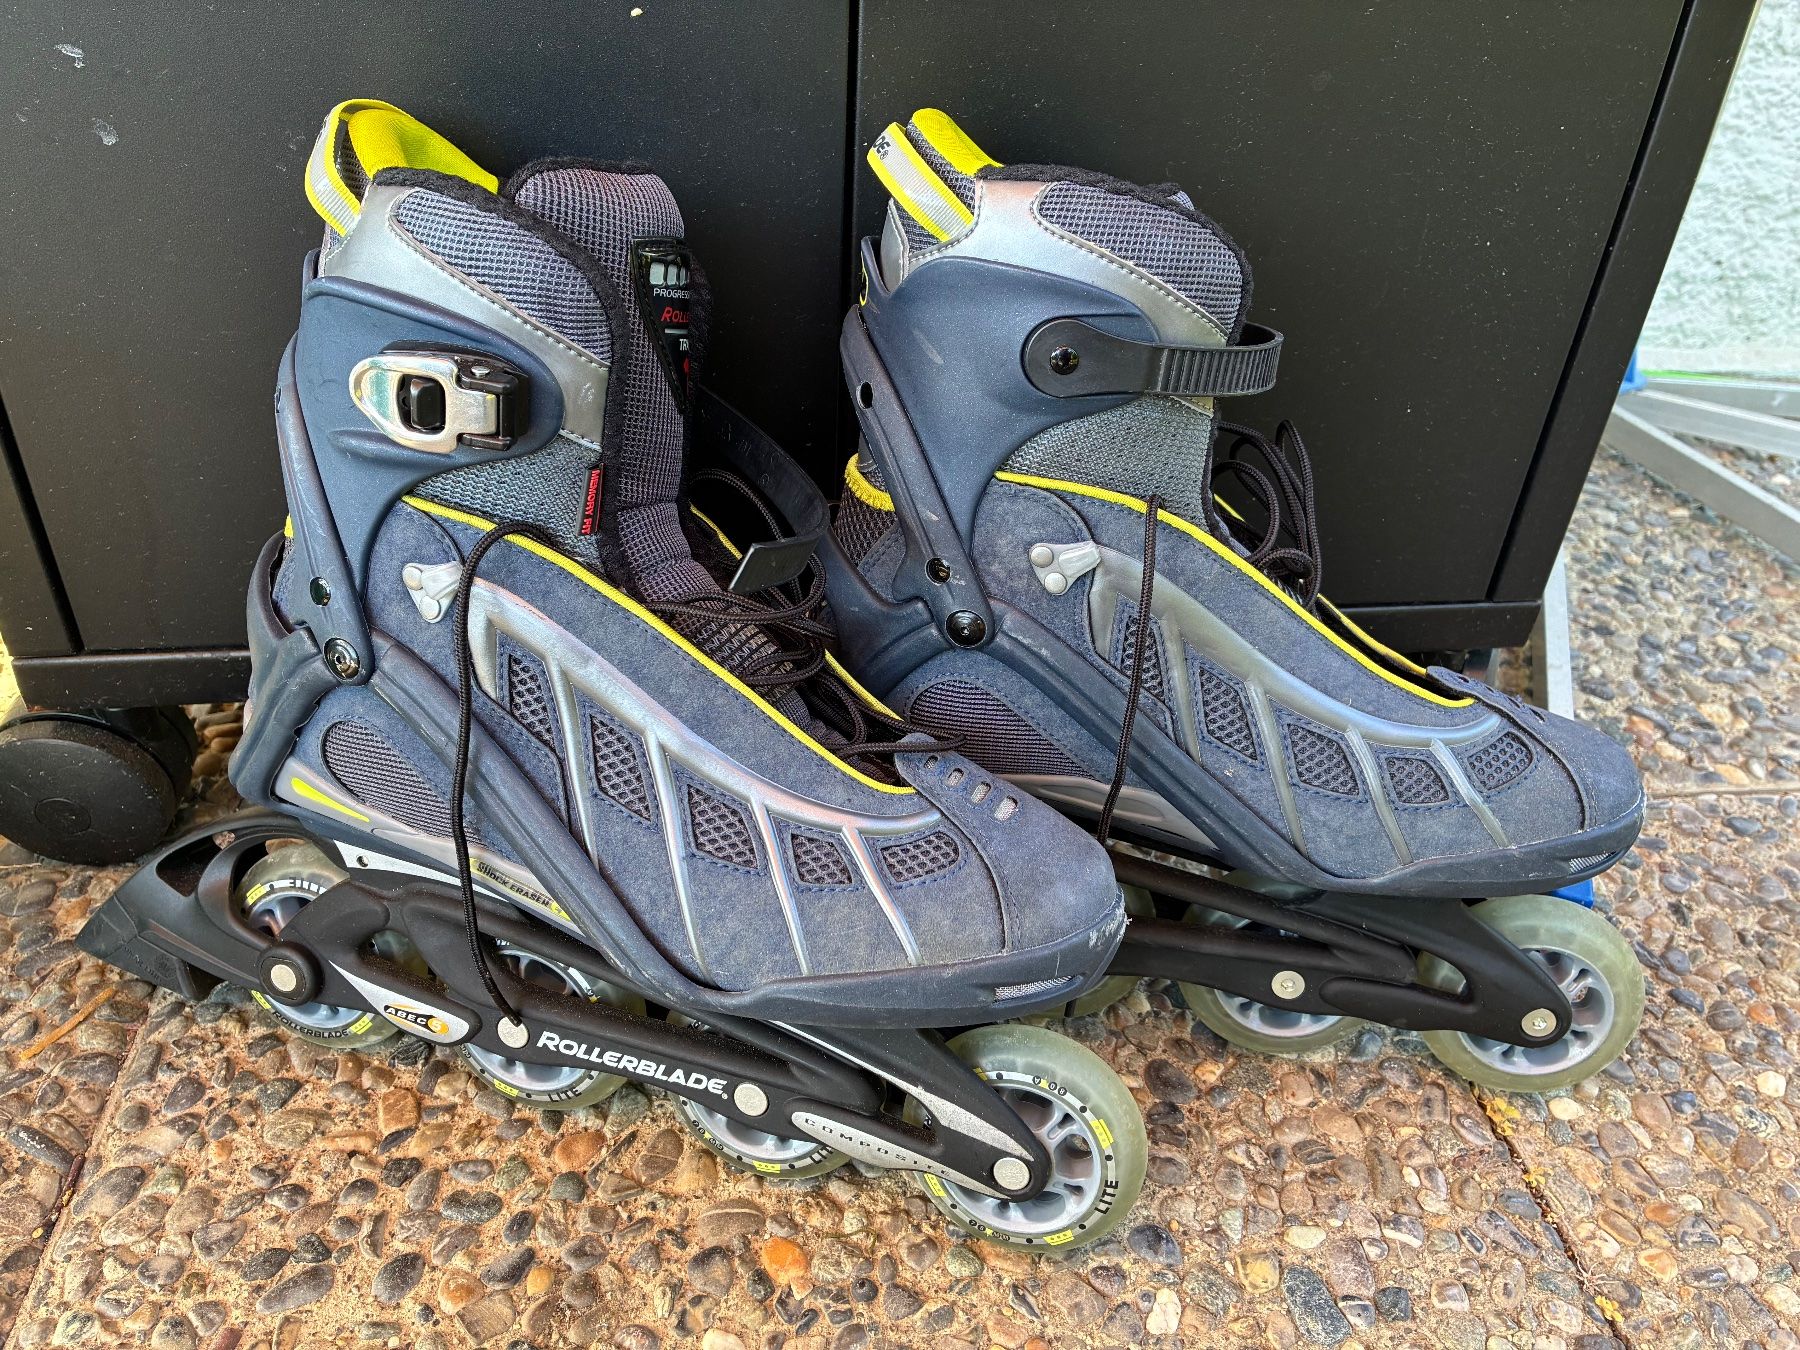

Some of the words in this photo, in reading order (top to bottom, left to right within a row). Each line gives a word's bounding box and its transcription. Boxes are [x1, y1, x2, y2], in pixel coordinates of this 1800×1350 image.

[585, 469, 600, 515] MEMORY
[581, 518, 592, 535] FIT
[477, 861, 508, 887] SHOCK
[509, 880, 550, 907] ERASER
[272, 1011, 349, 1038] ROLLERBLADE
[386, 1007, 426, 1025] ABEC
[536, 1030, 728, 1095] ROLLERBLADE
[548, 1087, 582, 1103] LITE
[1094, 1179, 1119, 1215] LITE
